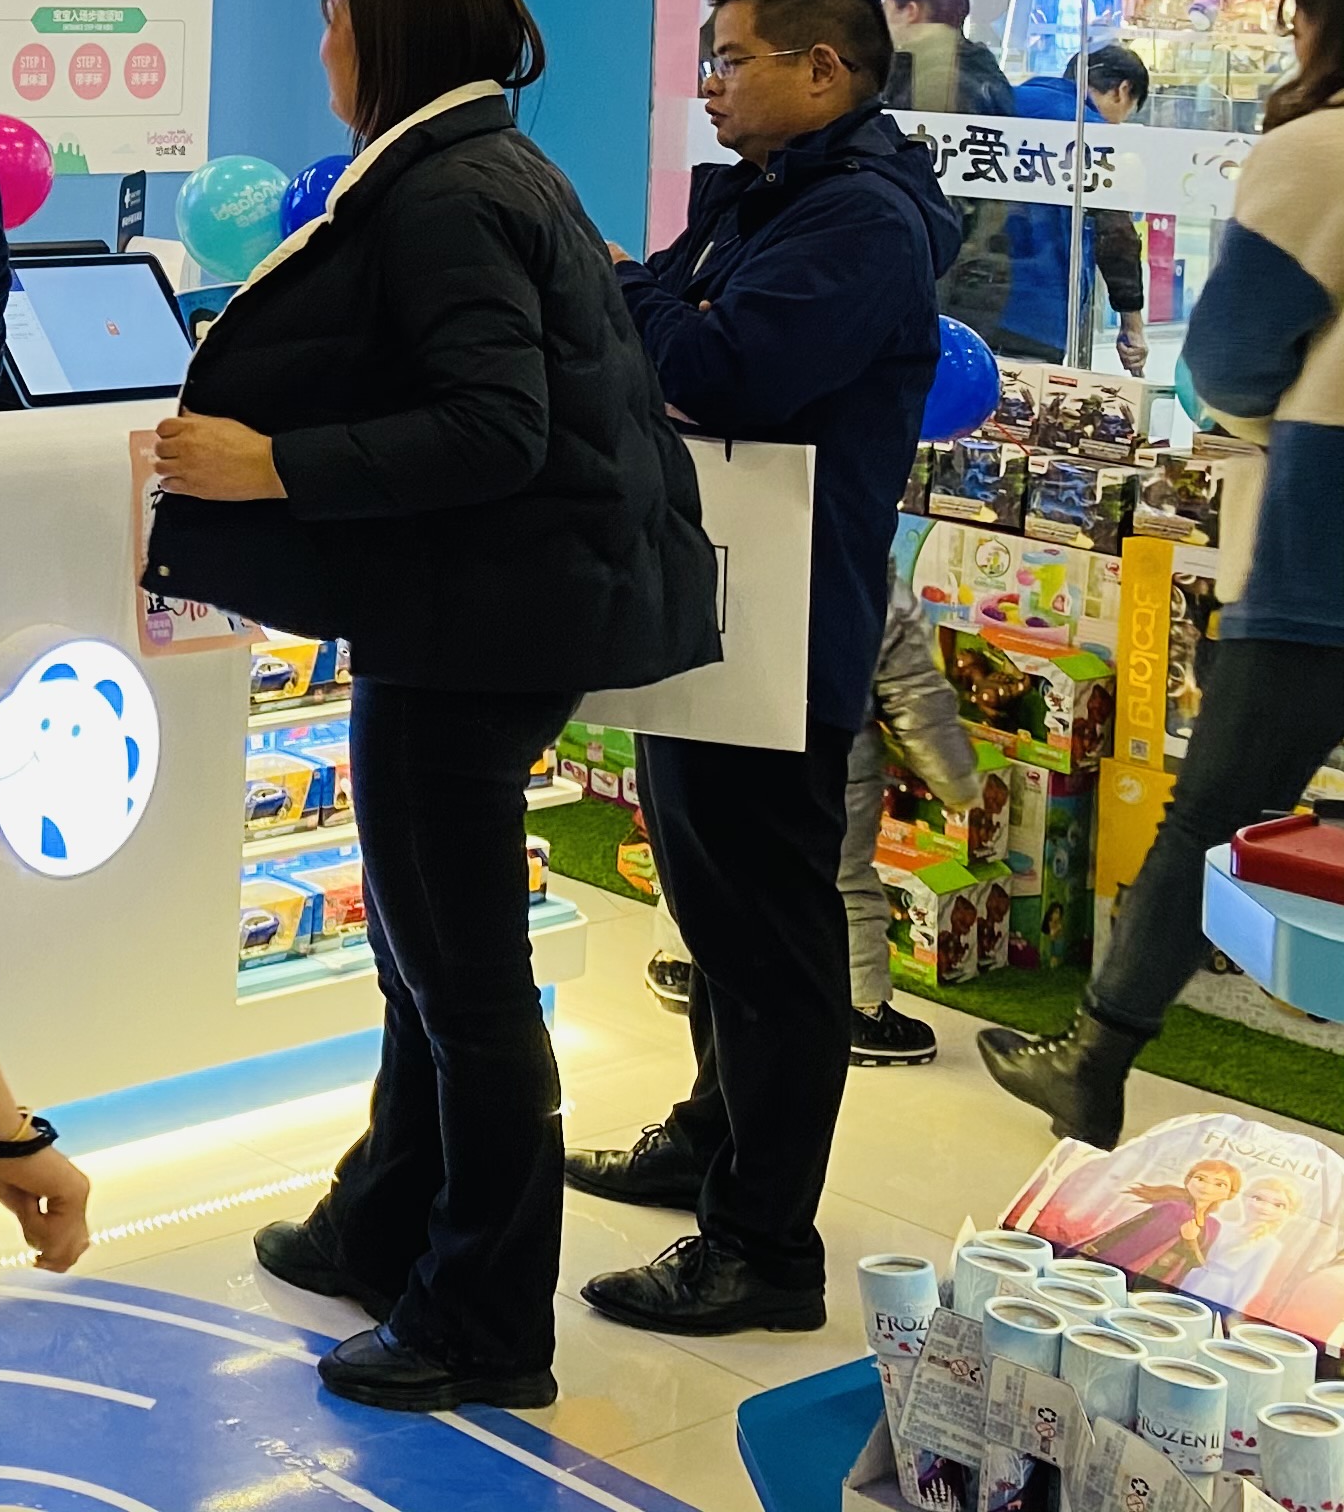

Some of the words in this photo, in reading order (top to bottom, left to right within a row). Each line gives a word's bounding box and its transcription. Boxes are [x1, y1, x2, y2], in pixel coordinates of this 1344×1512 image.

[20, 56, 40, 68] STEP
[42, 56, 46, 68] 1
[76, 56, 96, 68] STEP
[97, 56, 102, 68] 2
[132, 56, 151, 68] STEP
[152, 56, 158, 68] 3
[131, 73, 158, 86] 洗手手
[1204, 1129, 1296, 1176] FROZEN
[875, 1312, 931, 1332] FROZ
[1137, 1408, 1208, 1448] FROZEN
